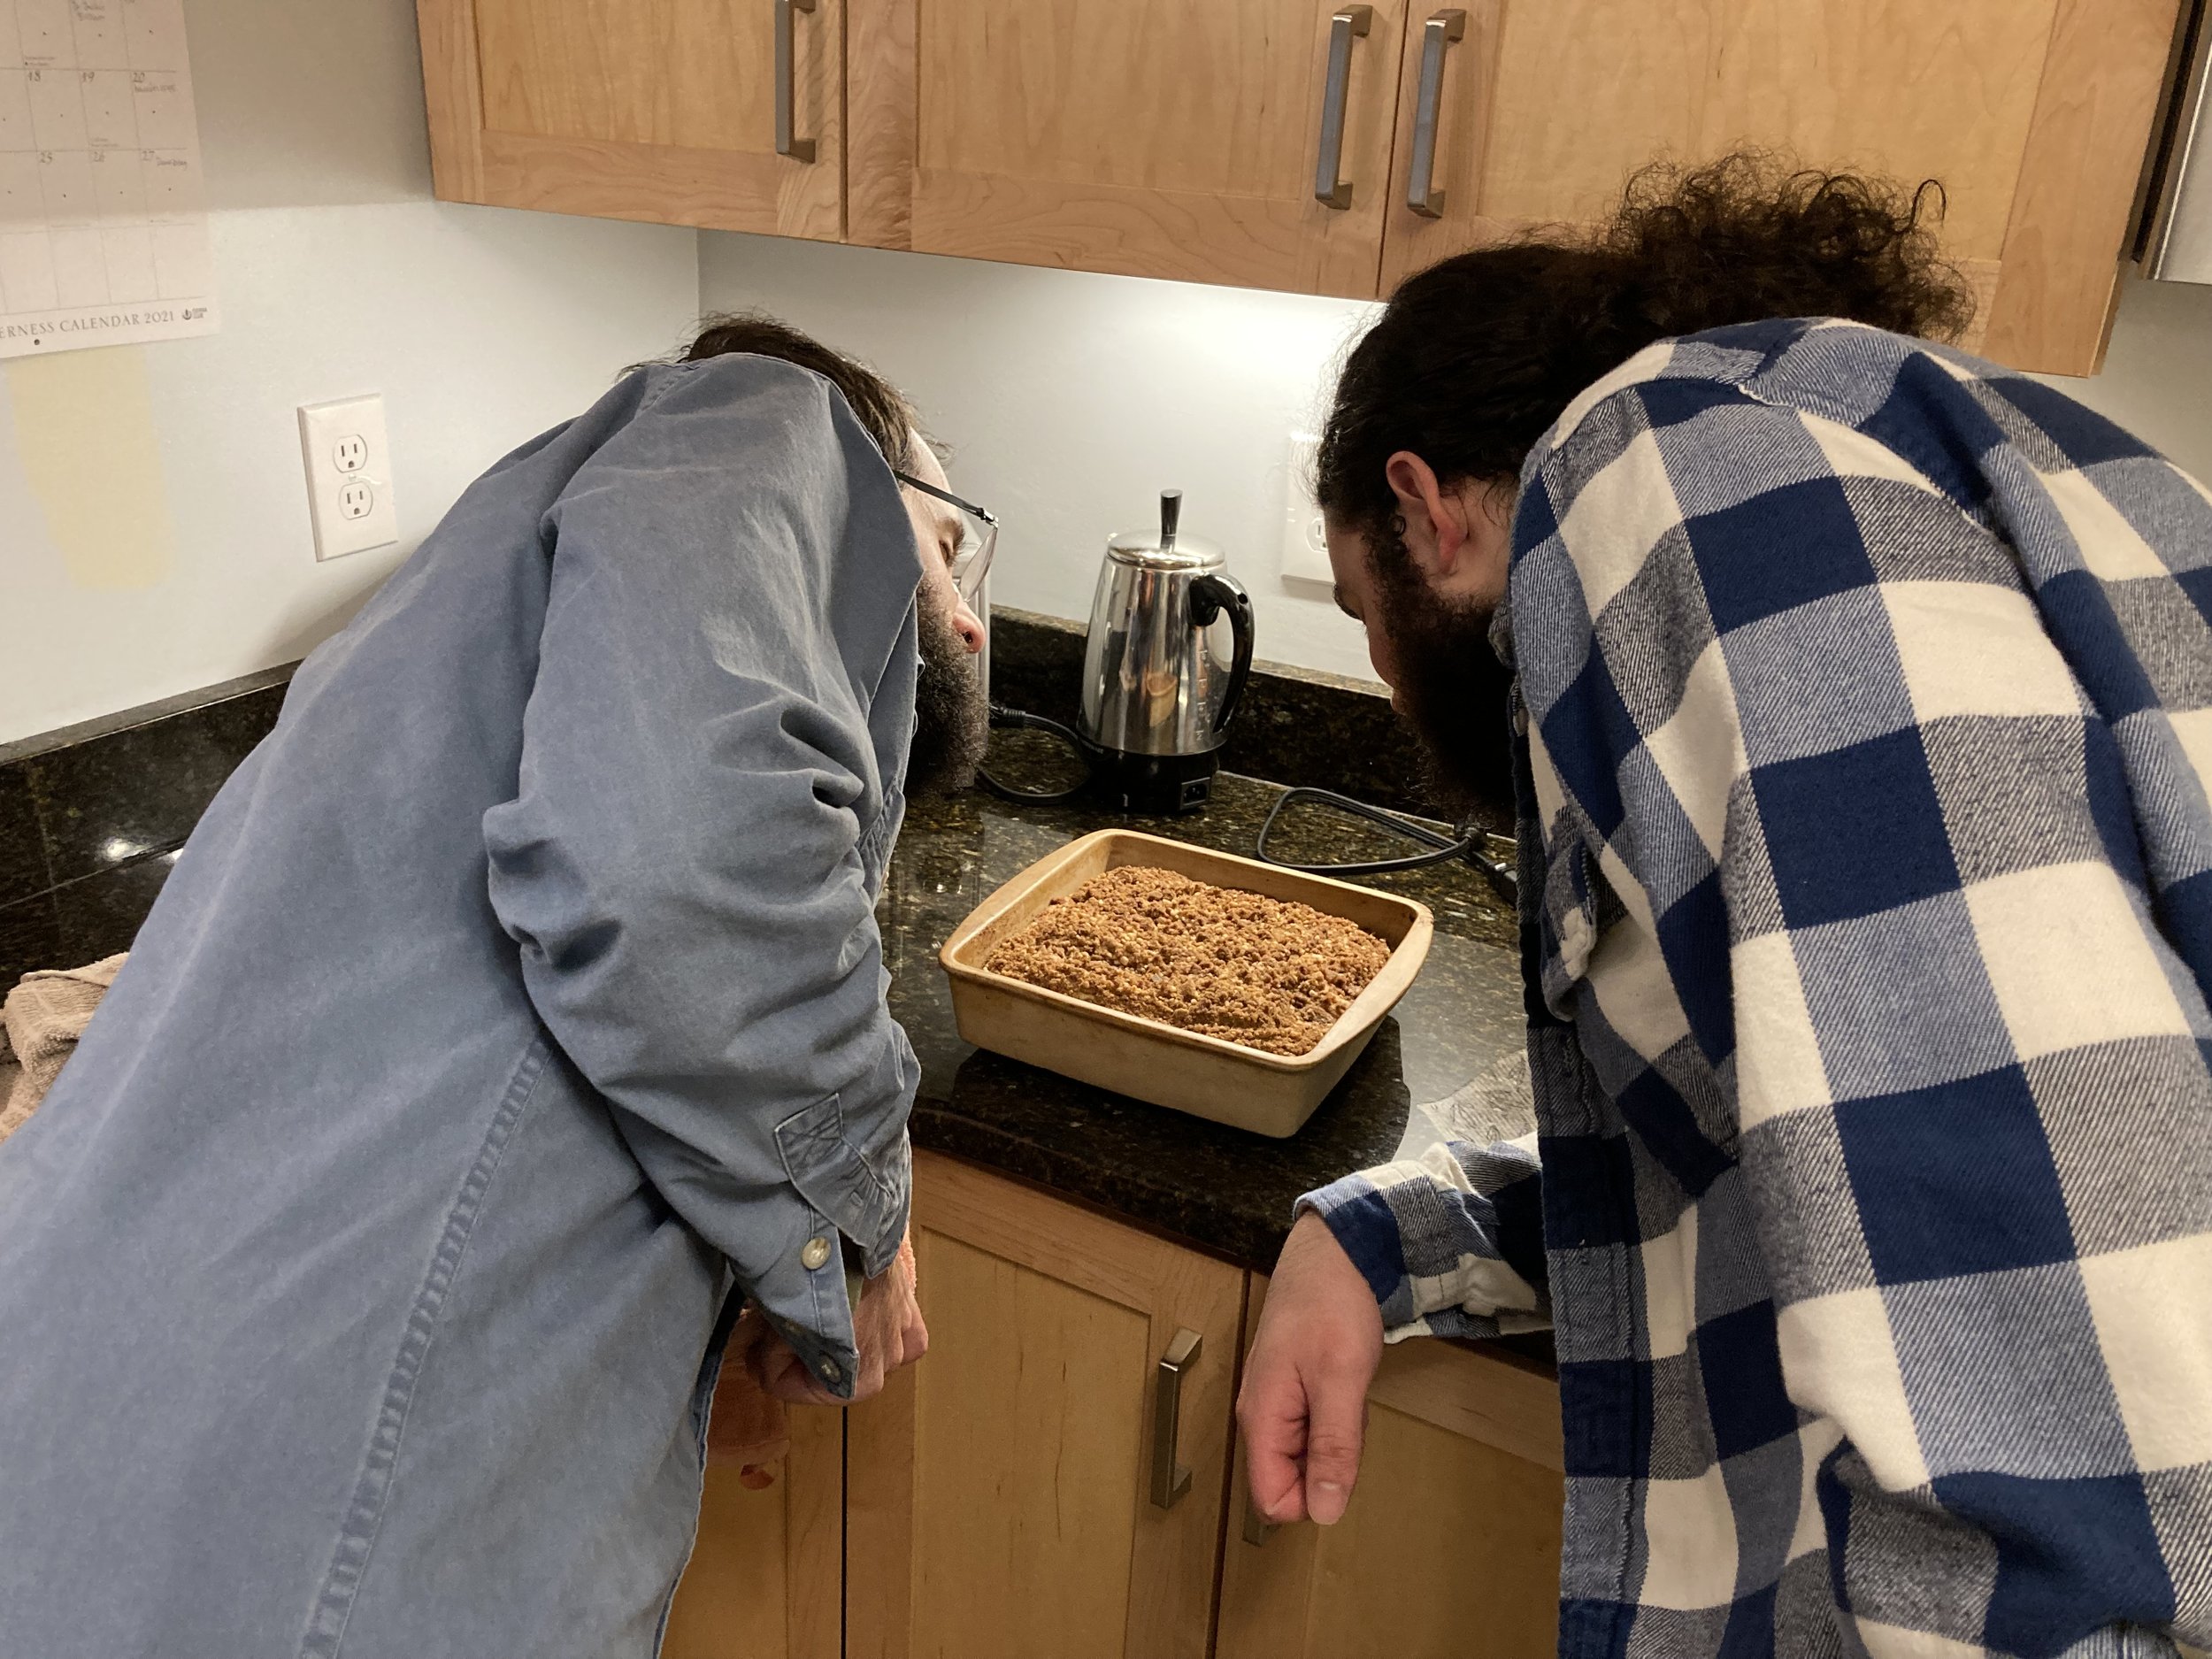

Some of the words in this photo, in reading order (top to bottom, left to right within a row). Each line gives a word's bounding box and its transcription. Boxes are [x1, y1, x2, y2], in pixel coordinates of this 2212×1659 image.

[28, 71, 41, 82] 18
[82, 71, 95, 82] 19
[133, 71, 146, 83] 20
[40, 151, 53, 165] 25
[142, 150, 154, 161] 27
[59, 313, 140, 332] CALENDAR
[144, 310, 173, 324] 2021
